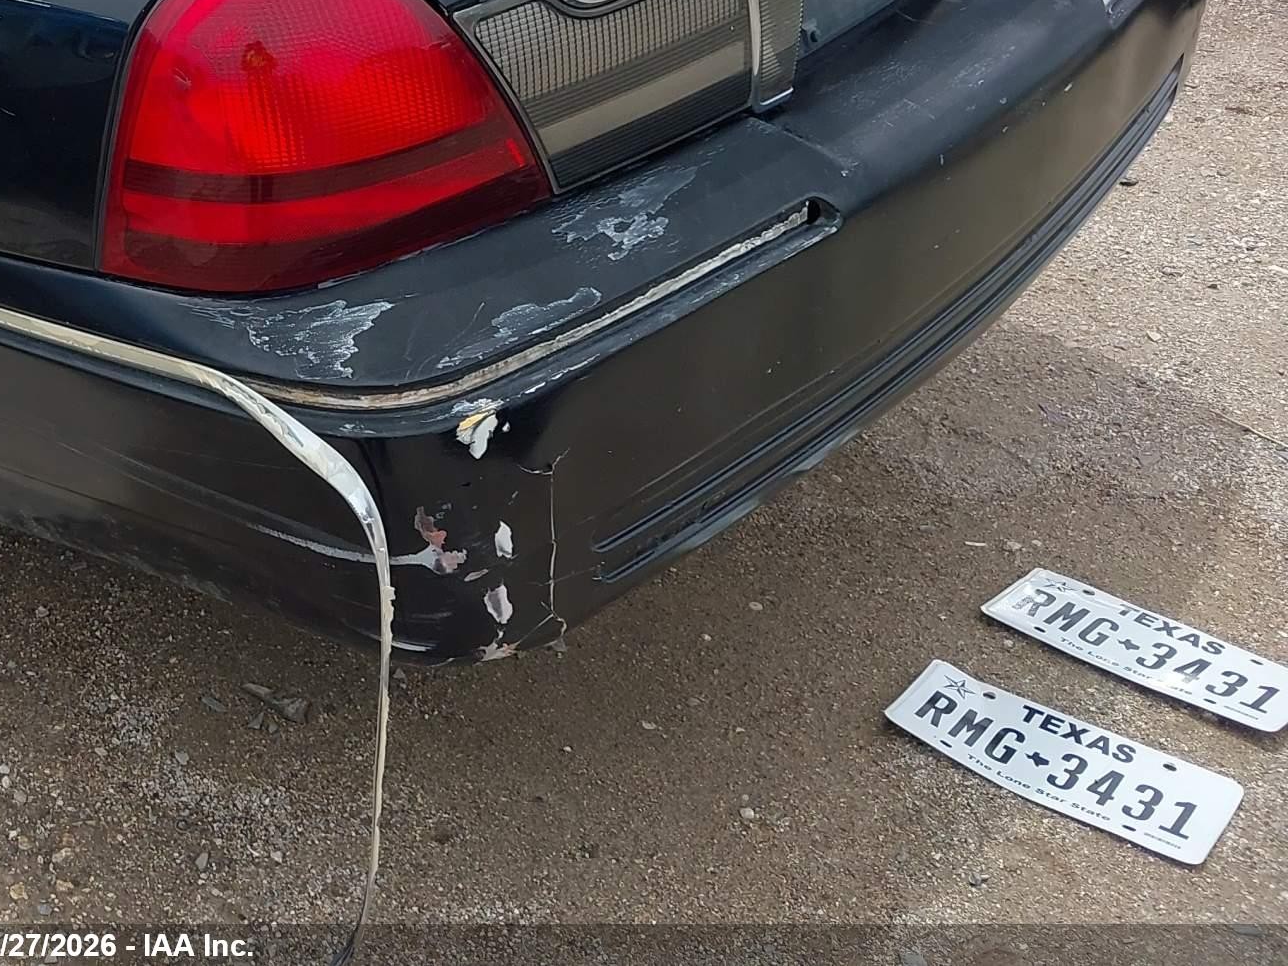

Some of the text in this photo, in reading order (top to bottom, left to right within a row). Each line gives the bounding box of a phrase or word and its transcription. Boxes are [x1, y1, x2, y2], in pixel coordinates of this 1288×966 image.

[1118, 603, 1226, 655] TEXAS
[1060, 636, 1084, 651] The
[1123, 665, 1153, 680] Star
[1158, 679, 1193, 695] ate
[1022, 704, 1137, 764] TEXAS
[967, 753, 1111, 822] The Lone Star State
